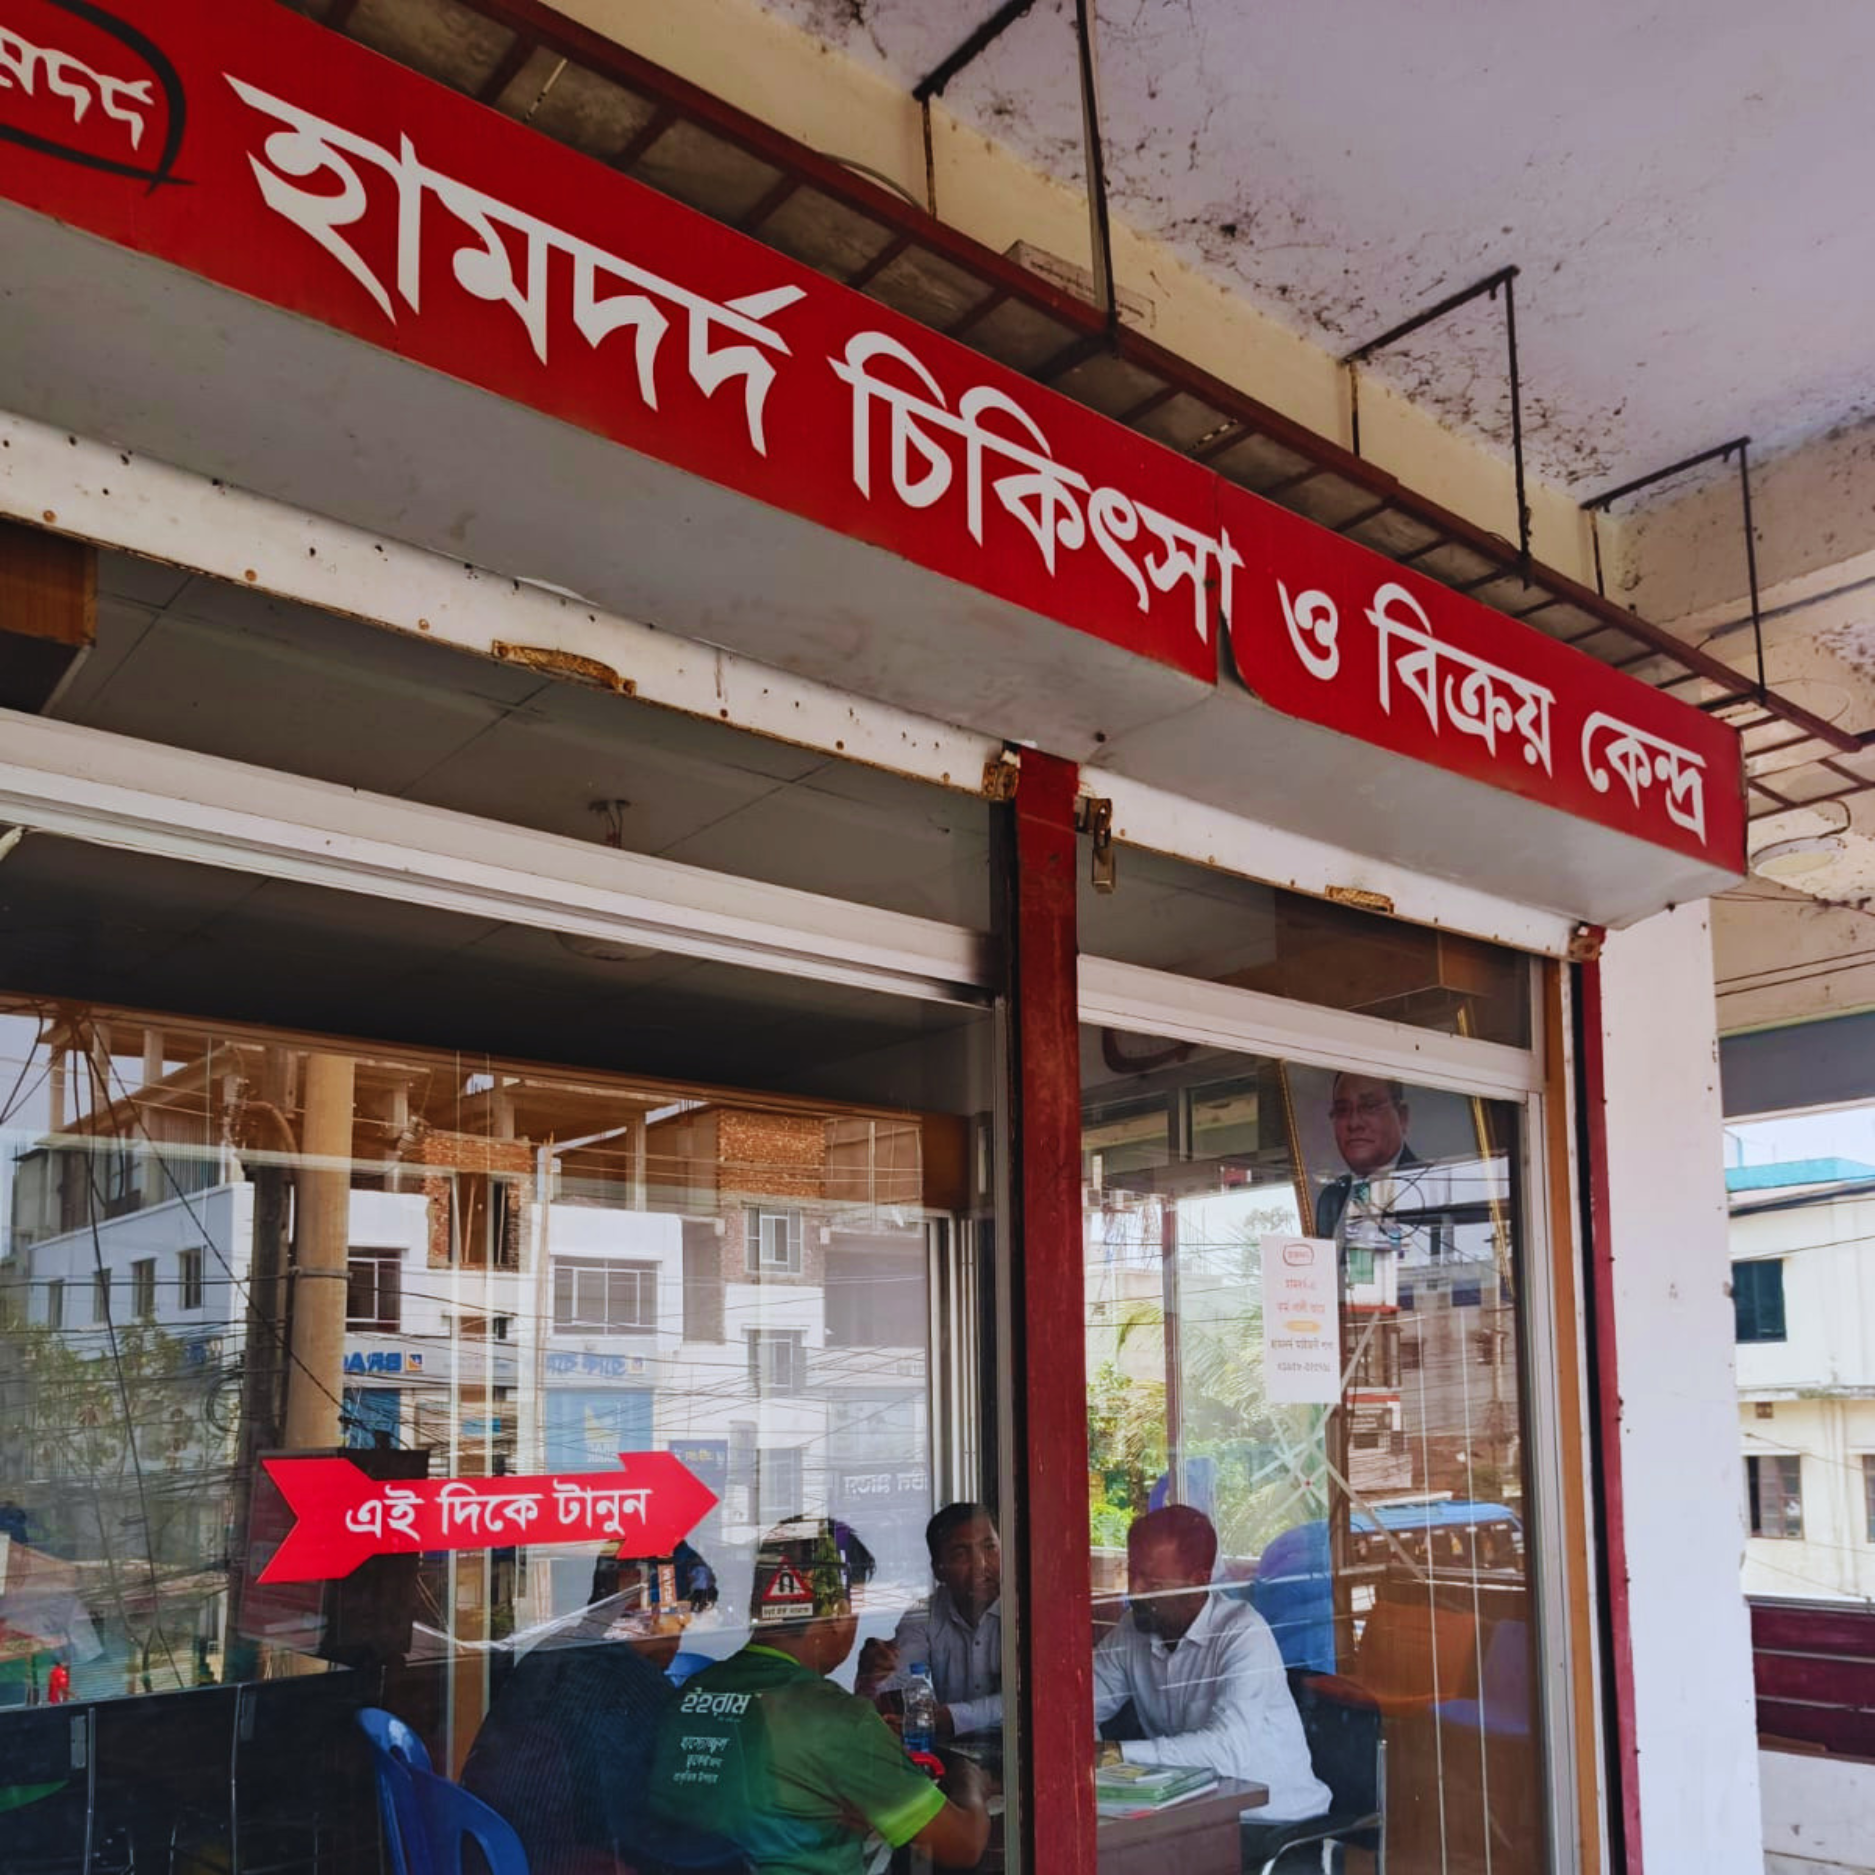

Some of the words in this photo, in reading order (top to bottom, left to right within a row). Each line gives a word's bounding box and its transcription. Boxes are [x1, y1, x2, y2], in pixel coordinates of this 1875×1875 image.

[224, 73, 807, 457] হামদর্দ
[828, 331, 1244, 644] চিকিৎসা
[1277, 580, 1340, 681] ও
[1365, 582, 1556, 778] বিক্রয়
[1582, 711, 1706, 845] কেন্দ্র
[346, 1485, 423, 1541] এই
[436, 1482, 544, 1535] দিকে
[553, 1478, 653, 1534] টানুন
